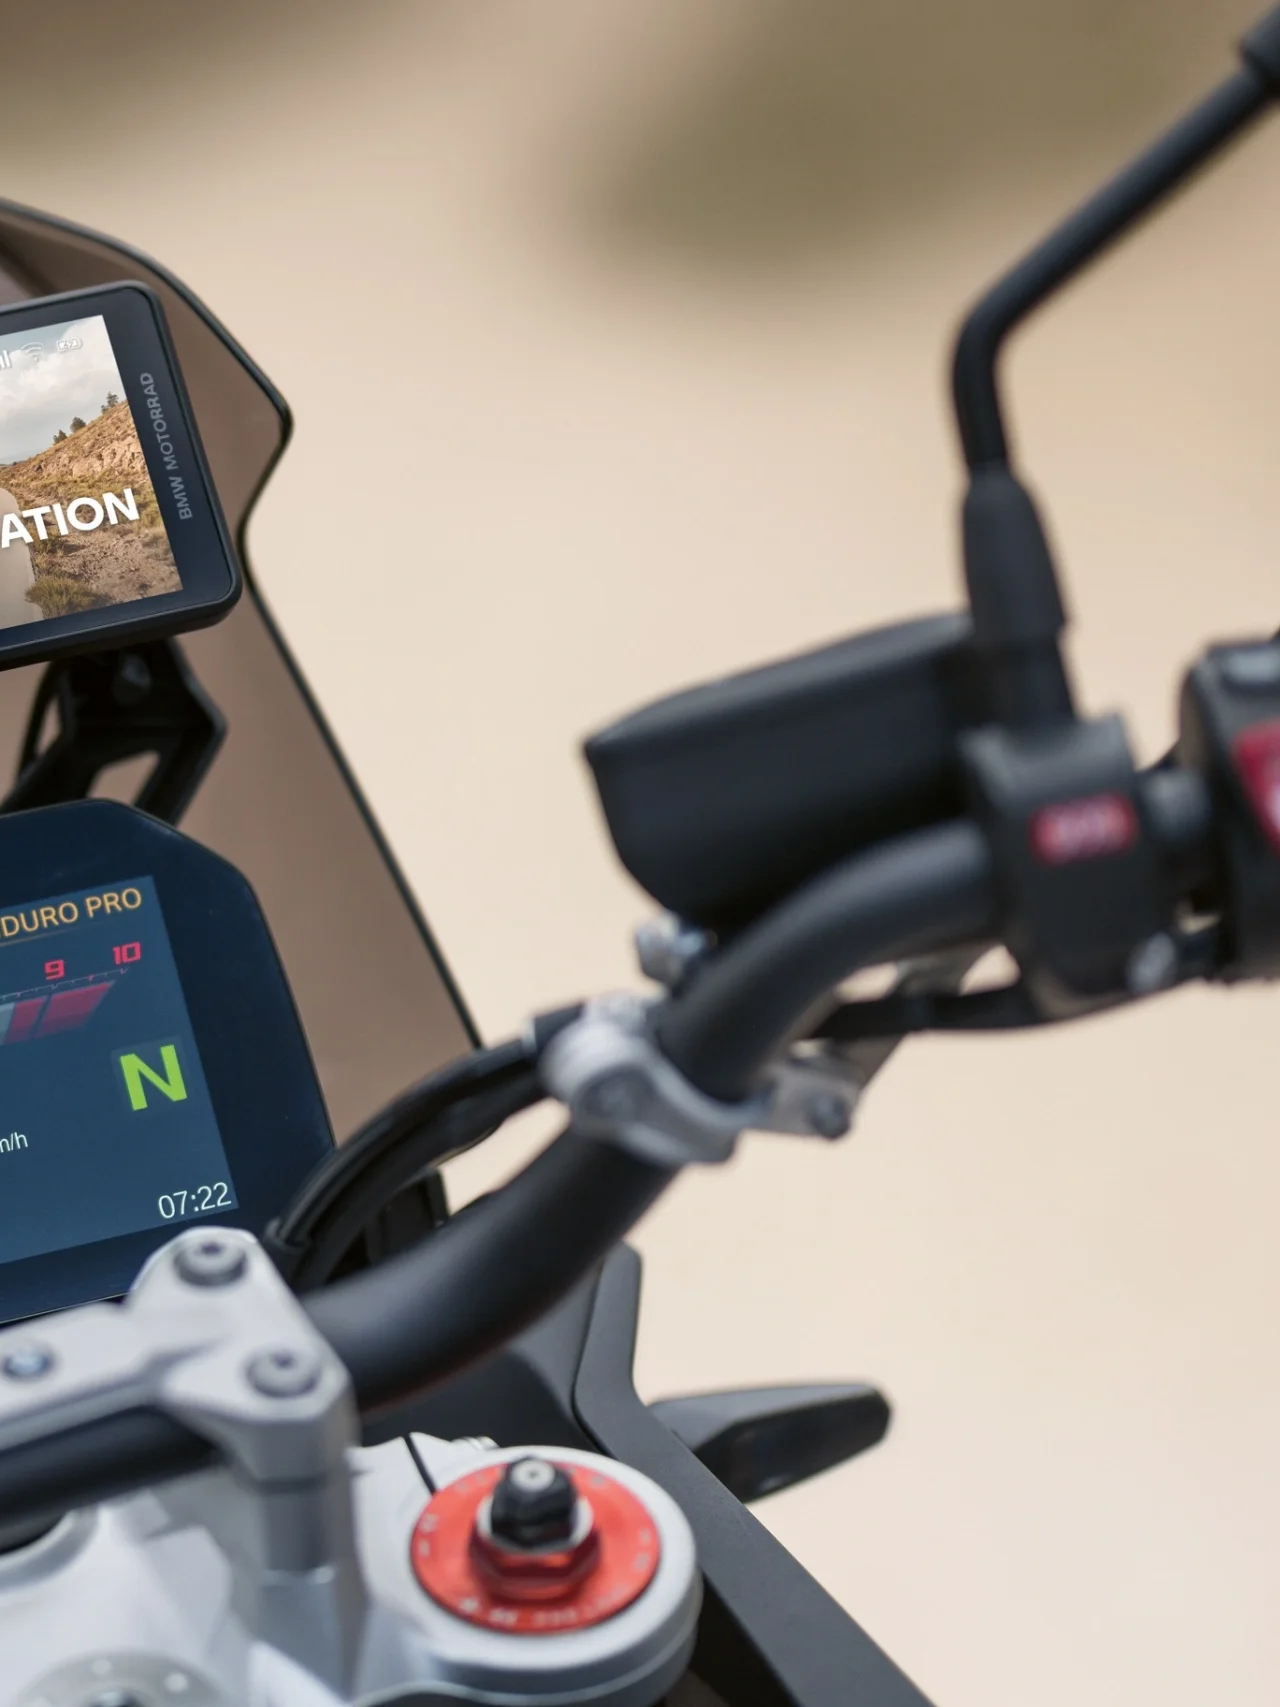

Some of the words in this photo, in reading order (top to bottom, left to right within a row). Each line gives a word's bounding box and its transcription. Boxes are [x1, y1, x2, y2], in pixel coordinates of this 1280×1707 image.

[140, 371, 179, 471] MOTORRAD
[168, 475, 194, 520] BMW
[84, 887, 143, 918] PRO
[44, 959, 65, 980] 9
[112, 941, 141, 965] 10
[120, 1044, 187, 1111] N
[157, 1182, 232, 1219] 07:22
